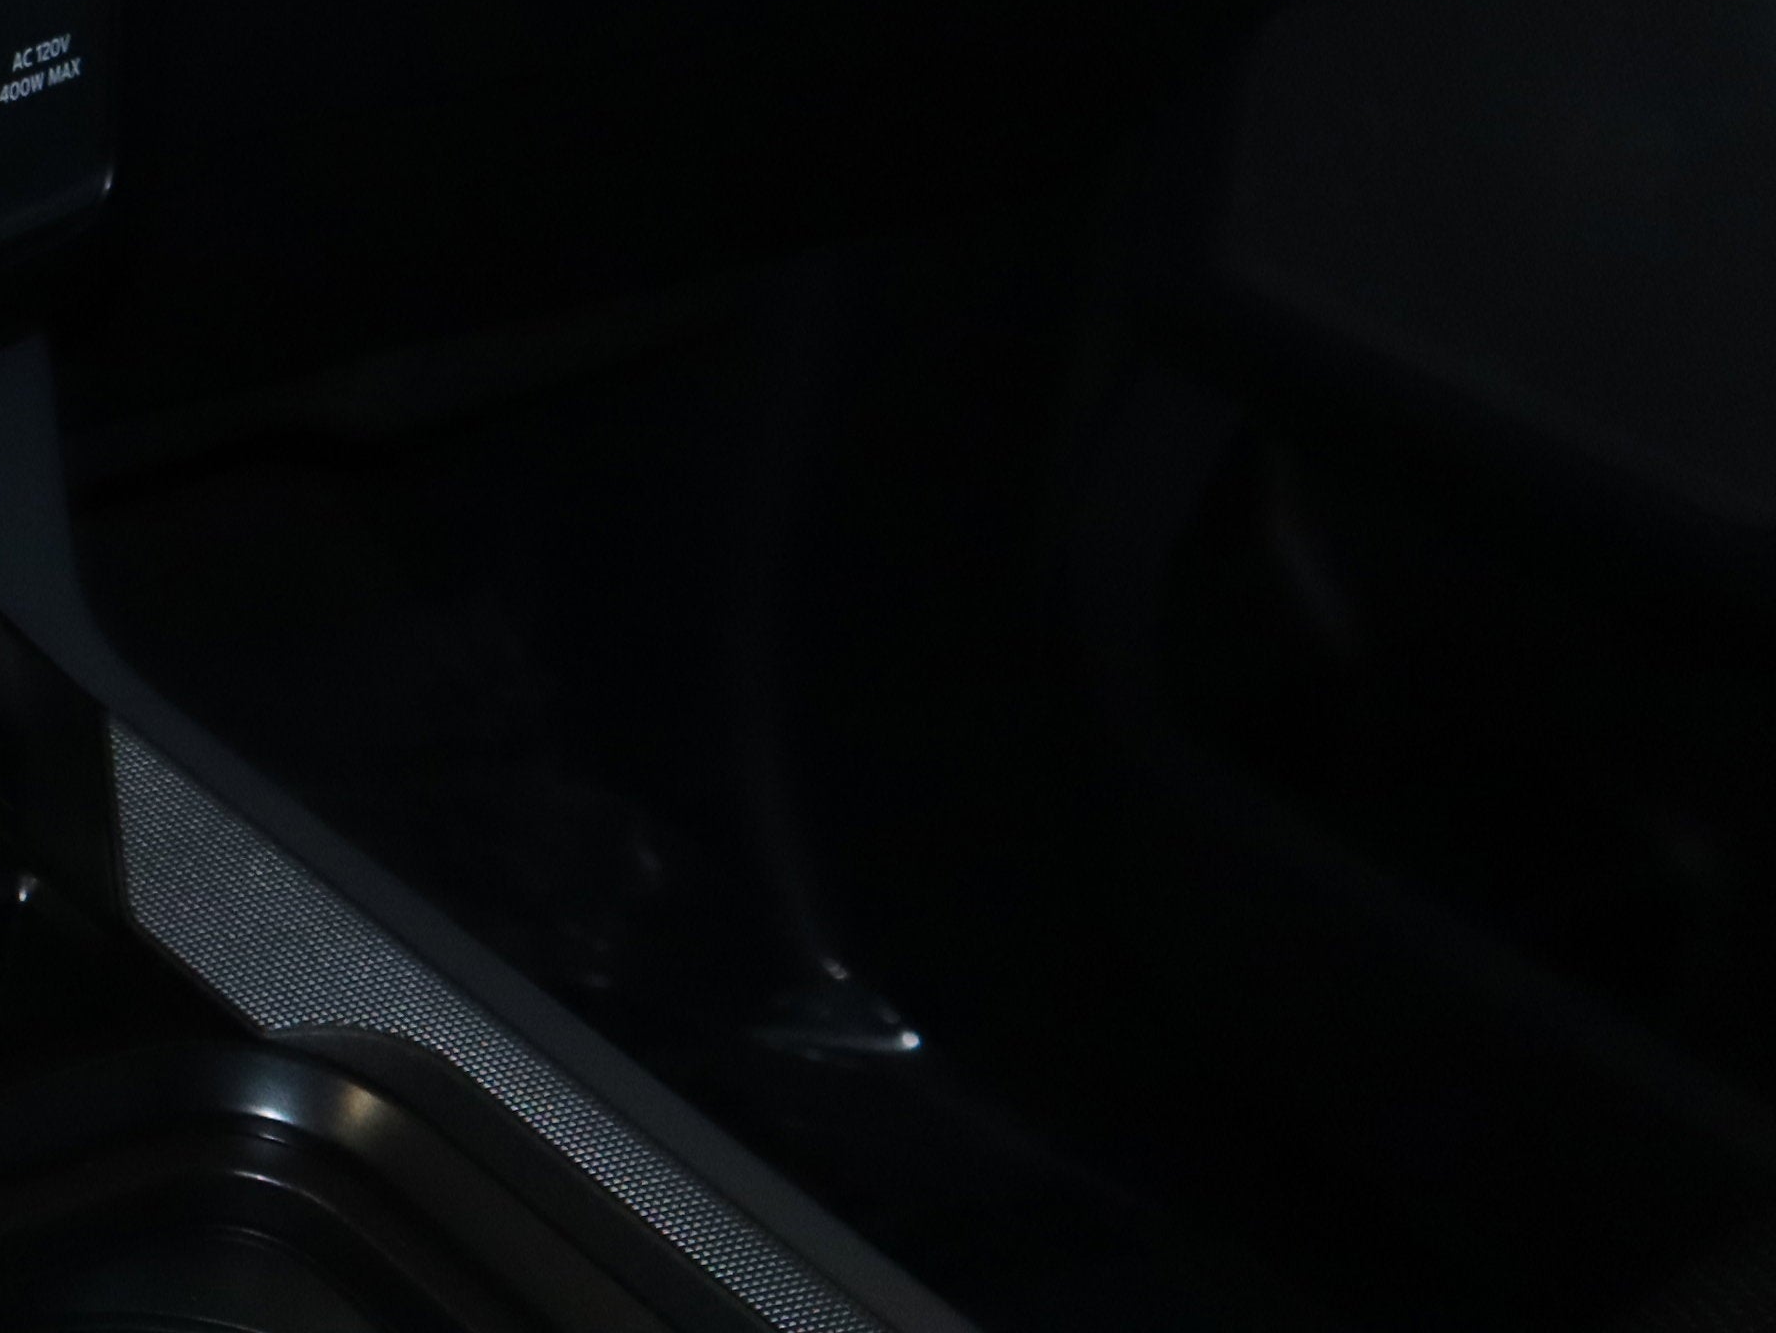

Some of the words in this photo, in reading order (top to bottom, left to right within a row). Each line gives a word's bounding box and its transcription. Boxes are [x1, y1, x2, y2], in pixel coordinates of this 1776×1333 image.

[12, 47, 33, 72] AC
[36, 33, 70, 62] 120V
[0, 72, 44, 103] 400W
[48, 58, 81, 86] MAX
